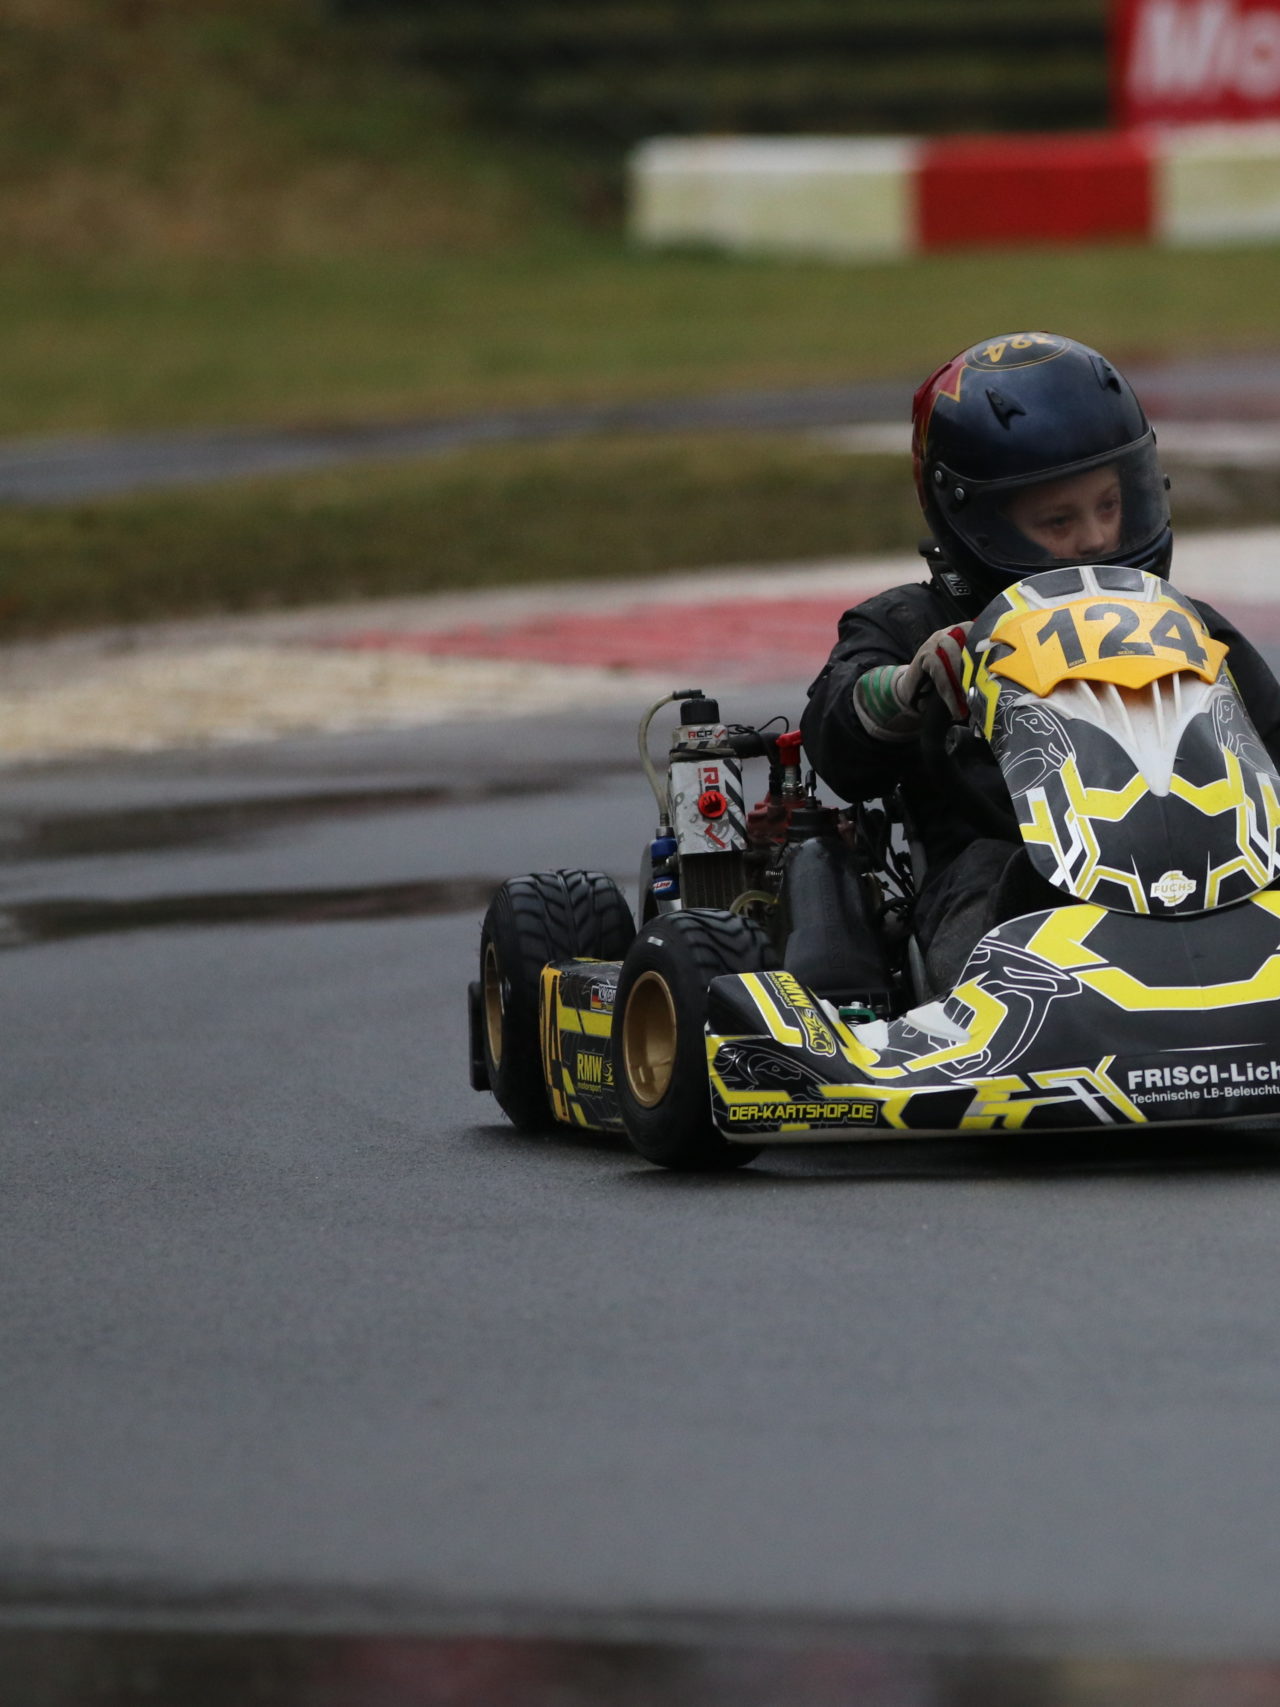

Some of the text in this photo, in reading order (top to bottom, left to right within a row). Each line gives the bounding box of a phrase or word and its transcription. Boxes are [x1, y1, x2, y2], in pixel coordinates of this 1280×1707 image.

[1035, 602, 1209, 671] 124
[1154, 882, 1194, 894] FUCHS
[772, 971, 815, 1009] RMW
[576, 1052, 603, 1083] RMW
[1131, 1084, 1201, 1105] Technische
[729, 1103, 875, 1121] DER-KARTSHOP.DE
